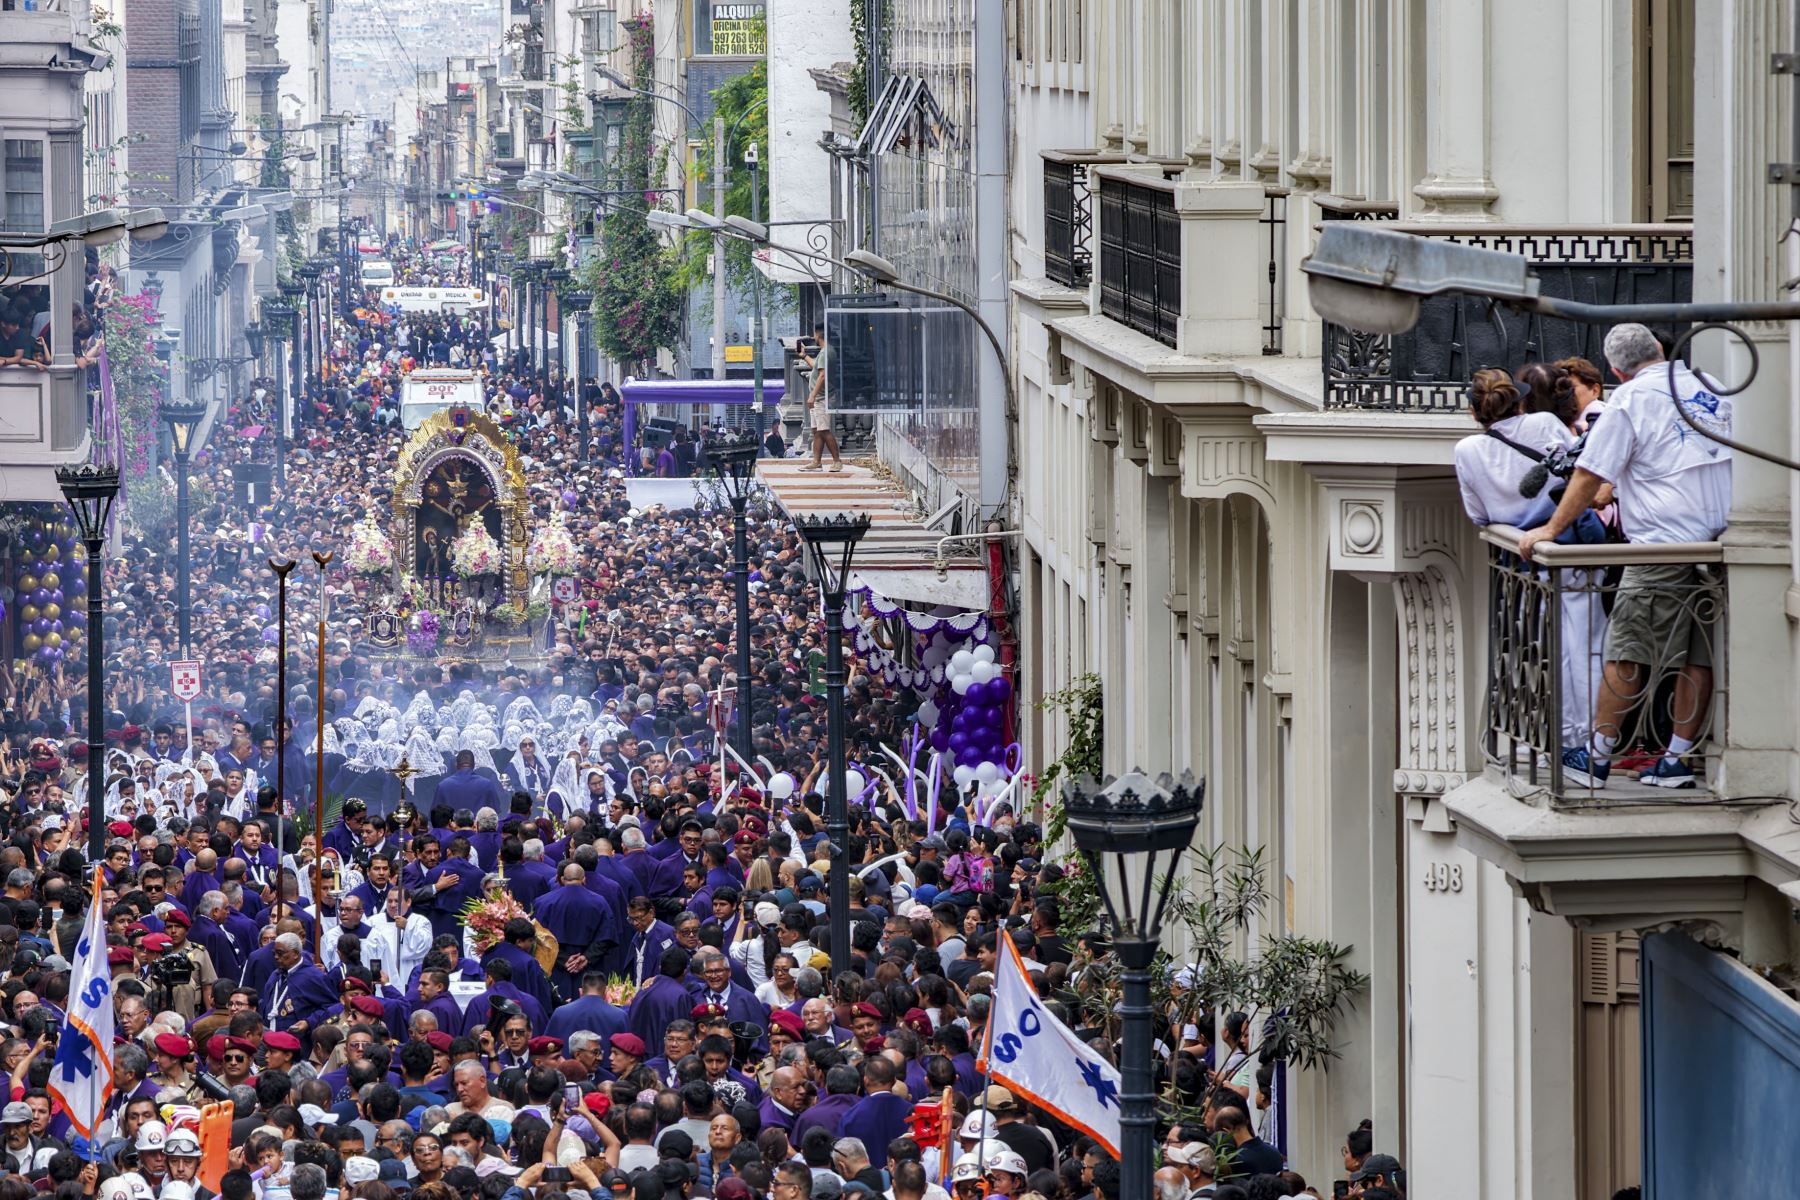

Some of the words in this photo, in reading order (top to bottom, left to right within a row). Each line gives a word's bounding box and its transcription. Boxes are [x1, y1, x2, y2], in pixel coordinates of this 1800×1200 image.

[714, 21, 741, 31] OFICINA
[714, 33, 729, 43] 997
[731, 32, 747, 43] 263
[714, 44, 729, 54] 967
[731, 44, 747, 54] 908
[749, 44, 765, 54] 529
[1424, 863, 1463, 893] 498
